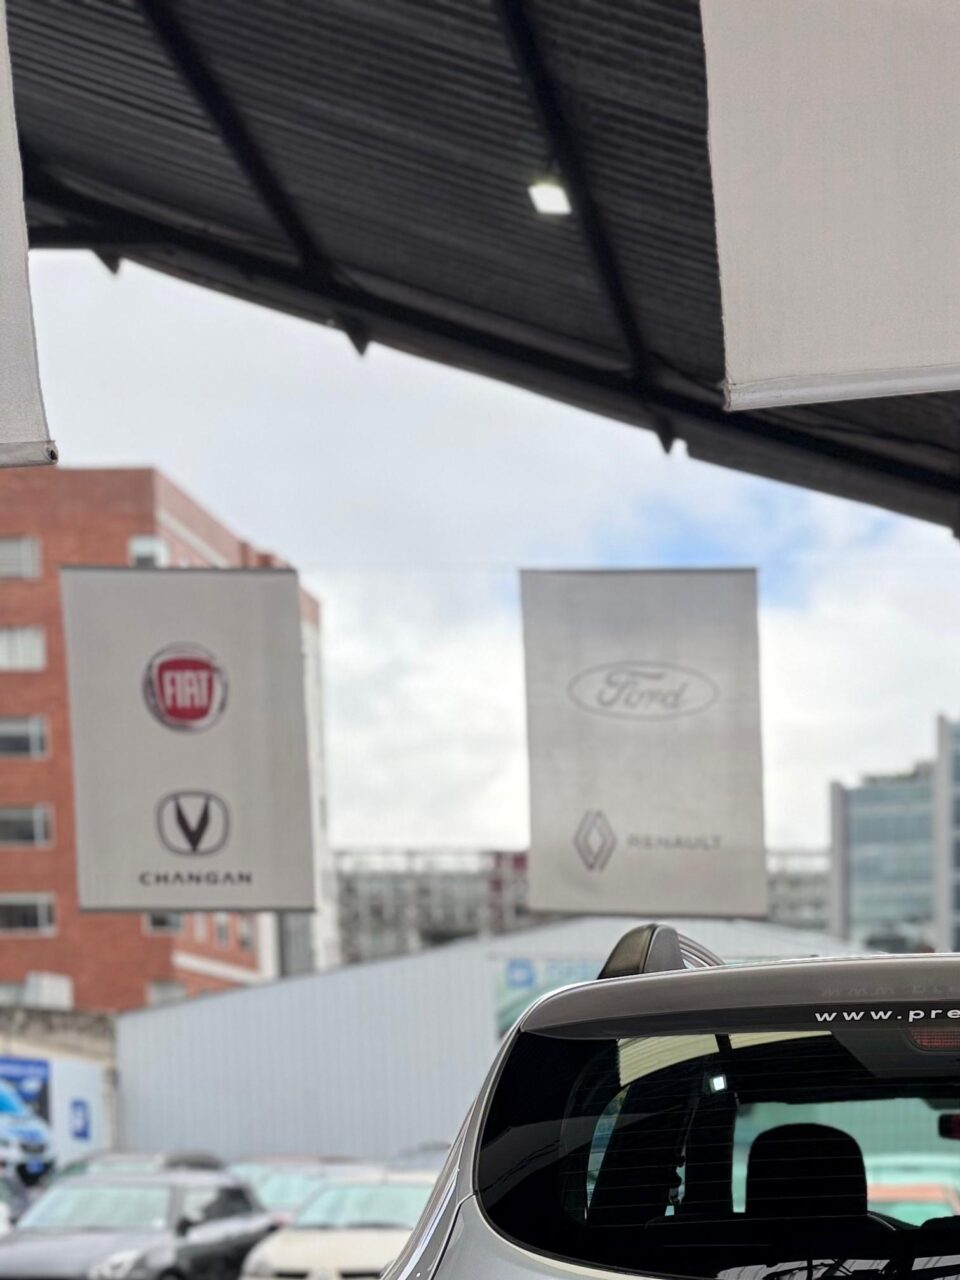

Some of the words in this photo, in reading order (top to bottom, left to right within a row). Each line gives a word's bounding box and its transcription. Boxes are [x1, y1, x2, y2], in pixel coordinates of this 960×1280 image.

[162, 669, 210, 709] FIAT
[597, 668, 689, 708] Ford
[138, 870, 253, 886] CHANGAN
